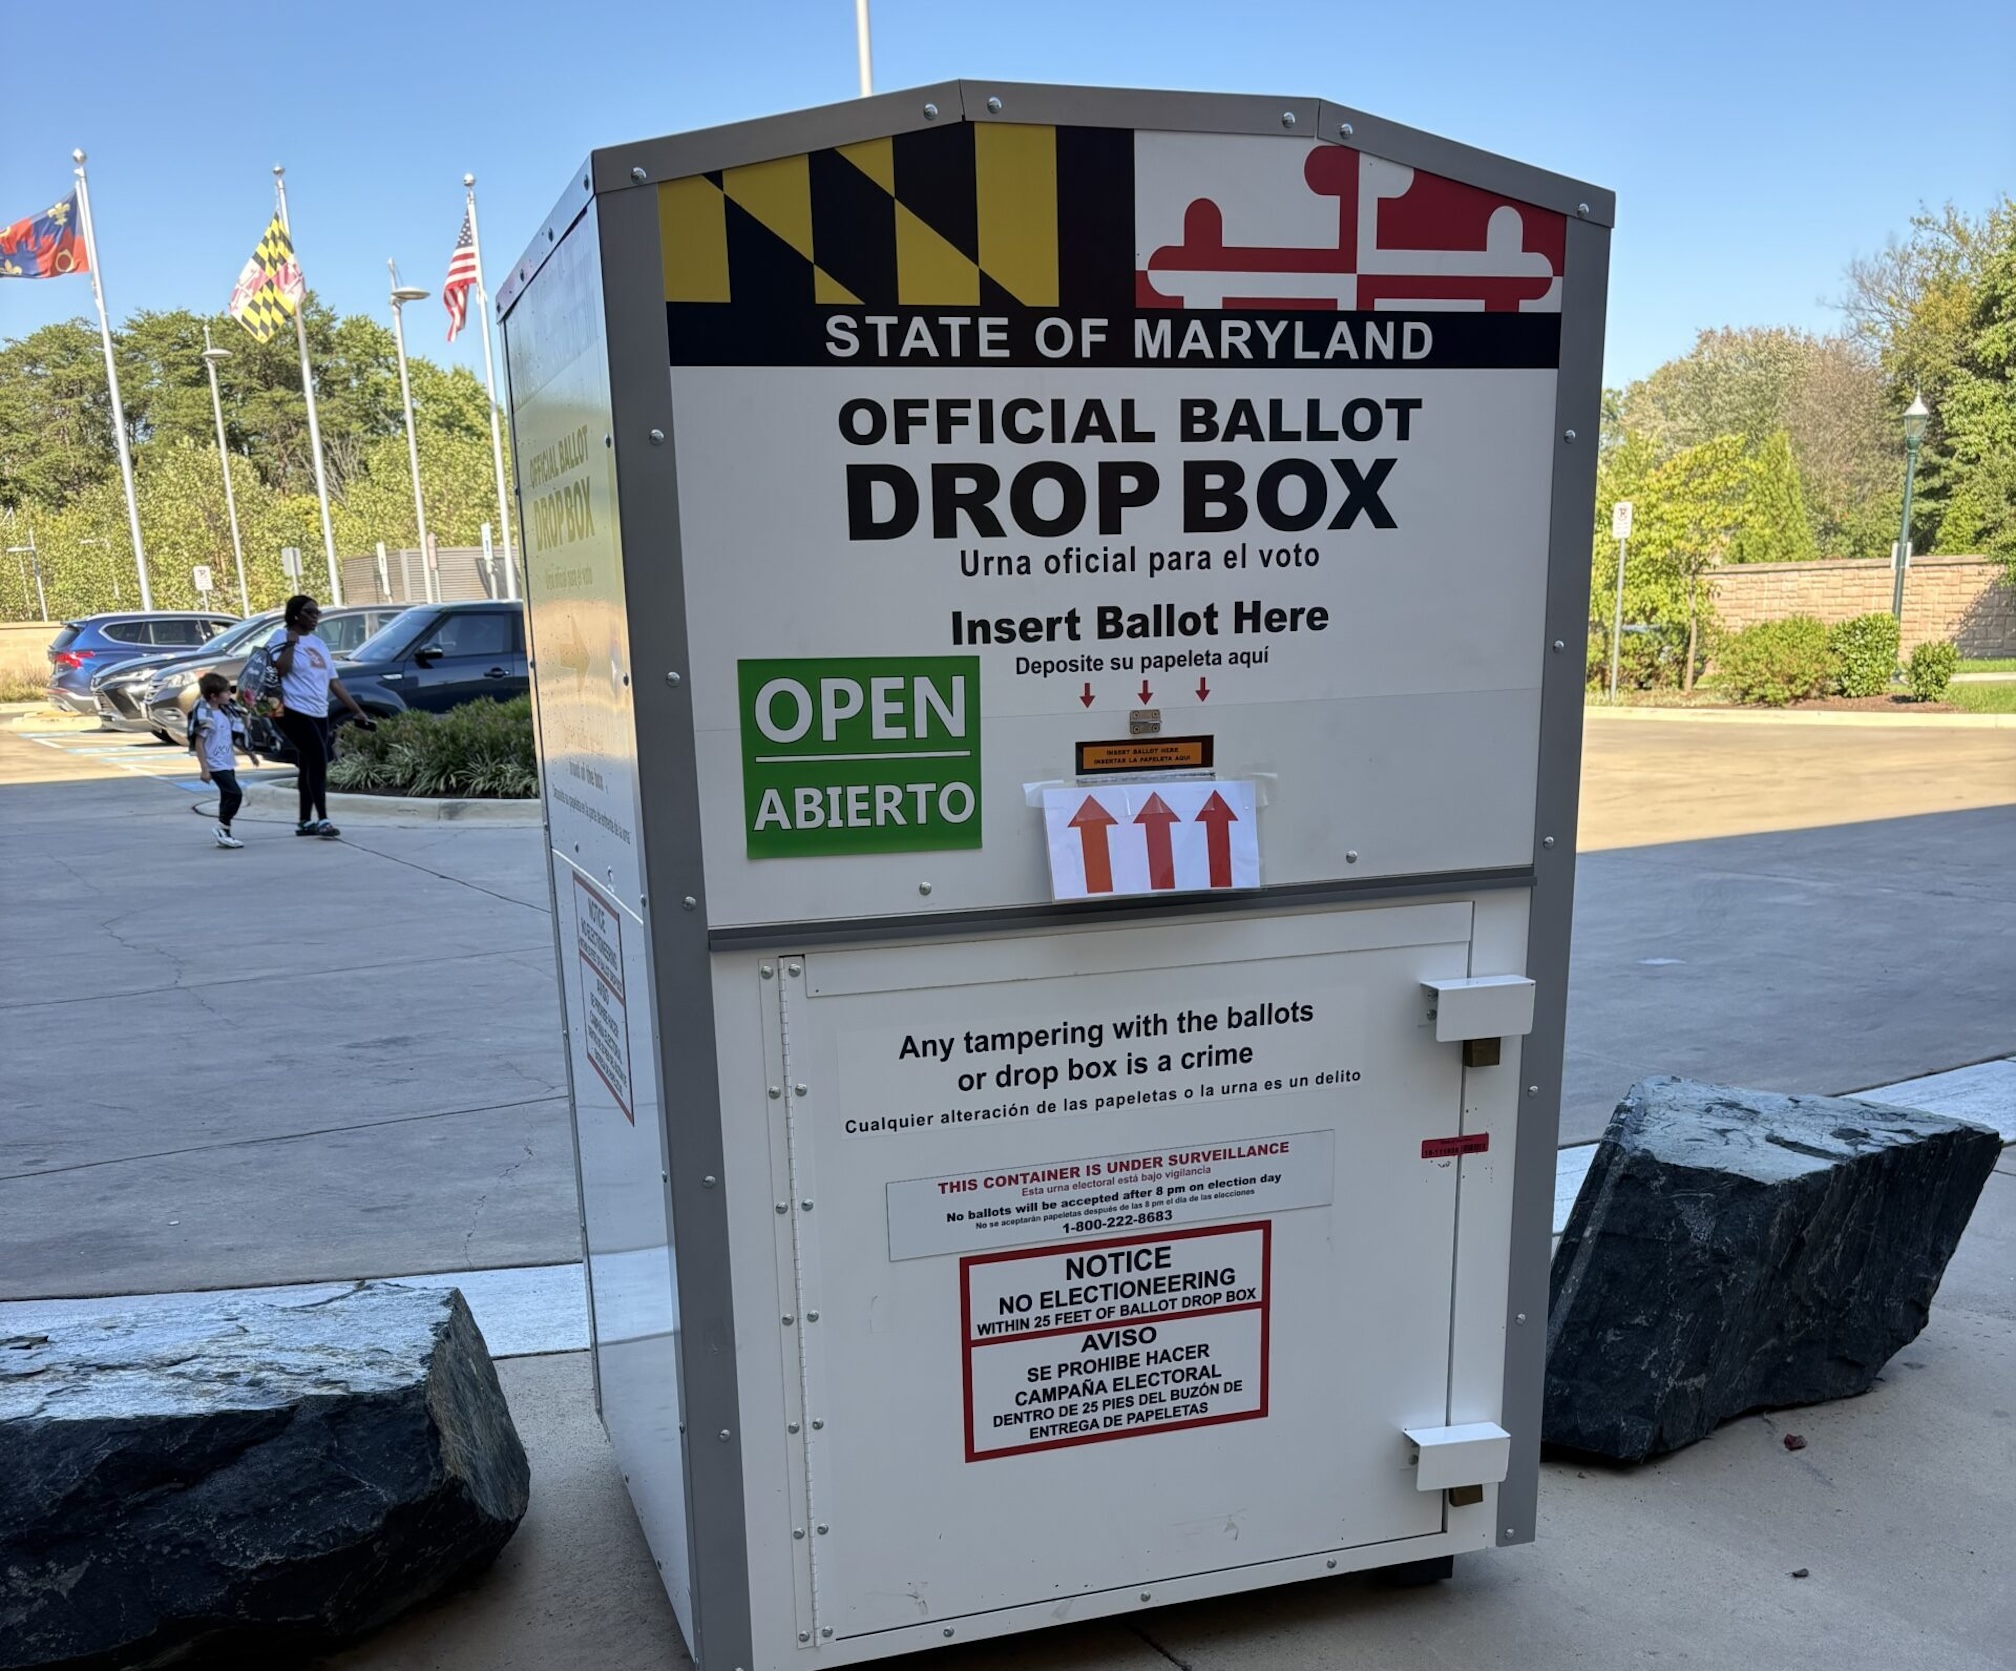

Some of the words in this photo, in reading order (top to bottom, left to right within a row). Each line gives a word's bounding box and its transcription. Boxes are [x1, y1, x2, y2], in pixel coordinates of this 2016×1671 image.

[825, 315, 1010, 358] STATE
[1035, 317, 1108, 358] OF
[1134, 319, 1434, 360] MARYLAND
[838, 398, 1155, 445] OFFICIAL
[1179, 398, 1422, 443] BALLOT
[530, 445, 559, 489] OFFICIAL
[559, 425, 589, 473] BALLOT
[534, 489, 563, 551] DROP
[564, 476, 595, 542] BOX
[845, 461, 1160, 540] DROP
[1184, 459, 1398, 532] BOX
[959, 547, 1032, 578] Urna
[1044, 546, 1136, 574] oficial
[1149, 546, 1211, 578] para
[1223, 543, 1248, 570] el
[1259, 543, 1320, 569] voto
[952, 608, 1080, 646] Insert
[1096, 603, 1219, 640] Ballot
[1234, 600, 1329, 633] Here
[1015, 654, 1103, 677] Deposite
[1110, 655, 1134, 671] su
[1140, 649, 1222, 673] papeleta
[1228, 647, 1269, 669] aquí
[755, 676, 966, 744] OPEN
[753, 782, 975, 831] ABIERTO
[899, 1035, 955, 1062] Any
[963, 1020, 1104, 1054] tampering
[1113, 1014, 1169, 1040] with
[1177, 1010, 1218, 1033] the
[1227, 1000, 1314, 1029] ballots
[958, 1069, 986, 1093] or
[996, 1058, 1059, 1090] drop
[1068, 1056, 1117, 1081] box
[1127, 1053, 1148, 1075] is
[1157, 1055, 1173, 1072] a
[1181, 1044, 1254, 1069] crime
[845, 1112, 934, 1134] Cualquier
[940, 1102, 1029, 1124] alteración
[1036, 1099, 1056, 1115] de
[1064, 1096, 1087, 1111] las
[1095, 1087, 1177, 1110] papeletas
[1185, 1088, 1194, 1099] o
[1200, 1083, 1214, 1097] la
[1221, 1080, 1258, 1095] urna
[1264, 1078, 1283, 1091] es
[1289, 1075, 1309, 1087] un
[1315, 1068, 1361, 1085] delito
[938, 1181, 977, 1194] THIS
[983, 1167, 1080, 1190] CONTAINER
[1086, 1164, 1101, 1176] IS
[1107, 1157, 1163, 1174] UNDER
[1169, 1142, 1289, 1167] SURVEILLANCE
[1022, 1188, 1043, 1196] Esta
[1047, 1185, 1070, 1193] urna
[1072, 1178, 1115, 1191] electoral
[1118, 1174, 1138, 1184] está
[1142, 1172, 1162, 1183] bajo
[1165, 1166, 1211, 1180] vigilancia
[946, 1212, 964, 1222] No
[968, 1206, 1012, 1220] ballots
[1016, 1201, 1038, 1213] will
[1042, 1200, 1057, 1211] be
[1061, 1194, 1119, 1210] accepted
[1122, 1188, 1152, 1200] after
[1156, 1185, 1163, 1195] 8
[1167, 1186, 1185, 1196] pm
[1190, 1183, 1204, 1193] on
[1208, 1176, 1256, 1190] election
[1260, 1173, 1281, 1186] day
[1044, 1210, 1082, 1221] papeletas
[1190, 1194, 1198, 1202] de
[1214, 1188, 1255, 1199] elecciones
[1063, 1210, 1172, 1234] 1-800-222-8683
[1066, 1246, 1172, 1281] NOTICE
[978, 1316, 1030, 1336] WITHIN
[1034, 1316, 1050, 1328] 25
[1055, 1310, 1092, 1326] FEET
[1096, 1307, 1115, 1320] OF
[1120, 1299, 1177, 1317] BALLOT
[1182, 1293, 1221, 1308] DROP
[1226, 1288, 1256, 1302] BOX
[1000, 1294, 1032, 1315] NO
[1040, 1268, 1236, 1310] ELECTIONEERING
[1028, 1365, 1051, 1382] SE
[1058, 1353, 1140, 1378] PROHIBE
[1147, 1344, 1209, 1365] HACER
[1081, 1327, 1156, 1353] AVISO
[993, 1408, 1054, 1428] DENTRO
[1060, 1405, 1078, 1417] DE
[1083, 1401, 1098, 1413] 25
[1103, 1396, 1134, 1411] PIES
[1139, 1391, 1166, 1405] DEL
[1170, 1382, 1219, 1401] BUZÓN
[1224, 1380, 1243, 1393] DE
[1015, 1378, 1107, 1406] CAMPAÑA
[1113, 1364, 1221, 1392] ELECTORAL
[1030, 1419, 1099, 1439] ENTREGA
[1103, 1415, 1123, 1428] DE
[1127, 1402, 1208, 1425] PAPELETAS
